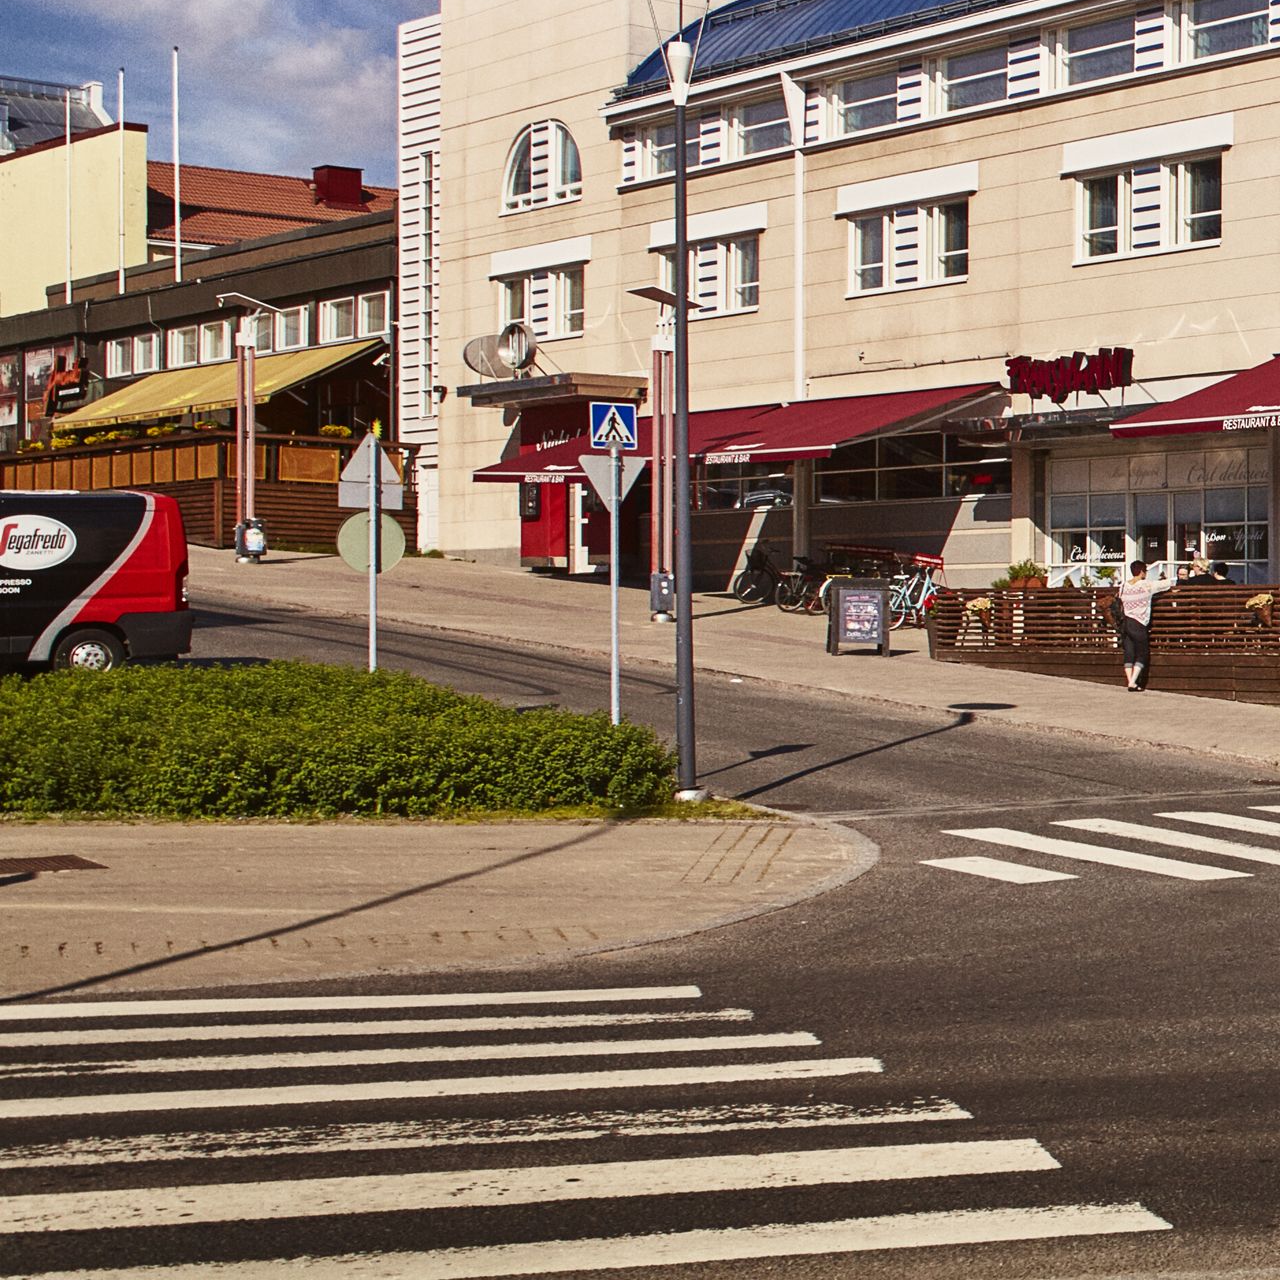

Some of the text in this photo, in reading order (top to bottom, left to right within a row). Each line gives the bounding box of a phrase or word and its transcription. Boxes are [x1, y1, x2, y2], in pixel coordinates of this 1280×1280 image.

[1222, 416, 1270, 431] RESTAURANT
[1270, 415, 1277, 427] &
[739, 453, 751, 464] BAR
[524, 474, 550, 484] RESTAURANT
